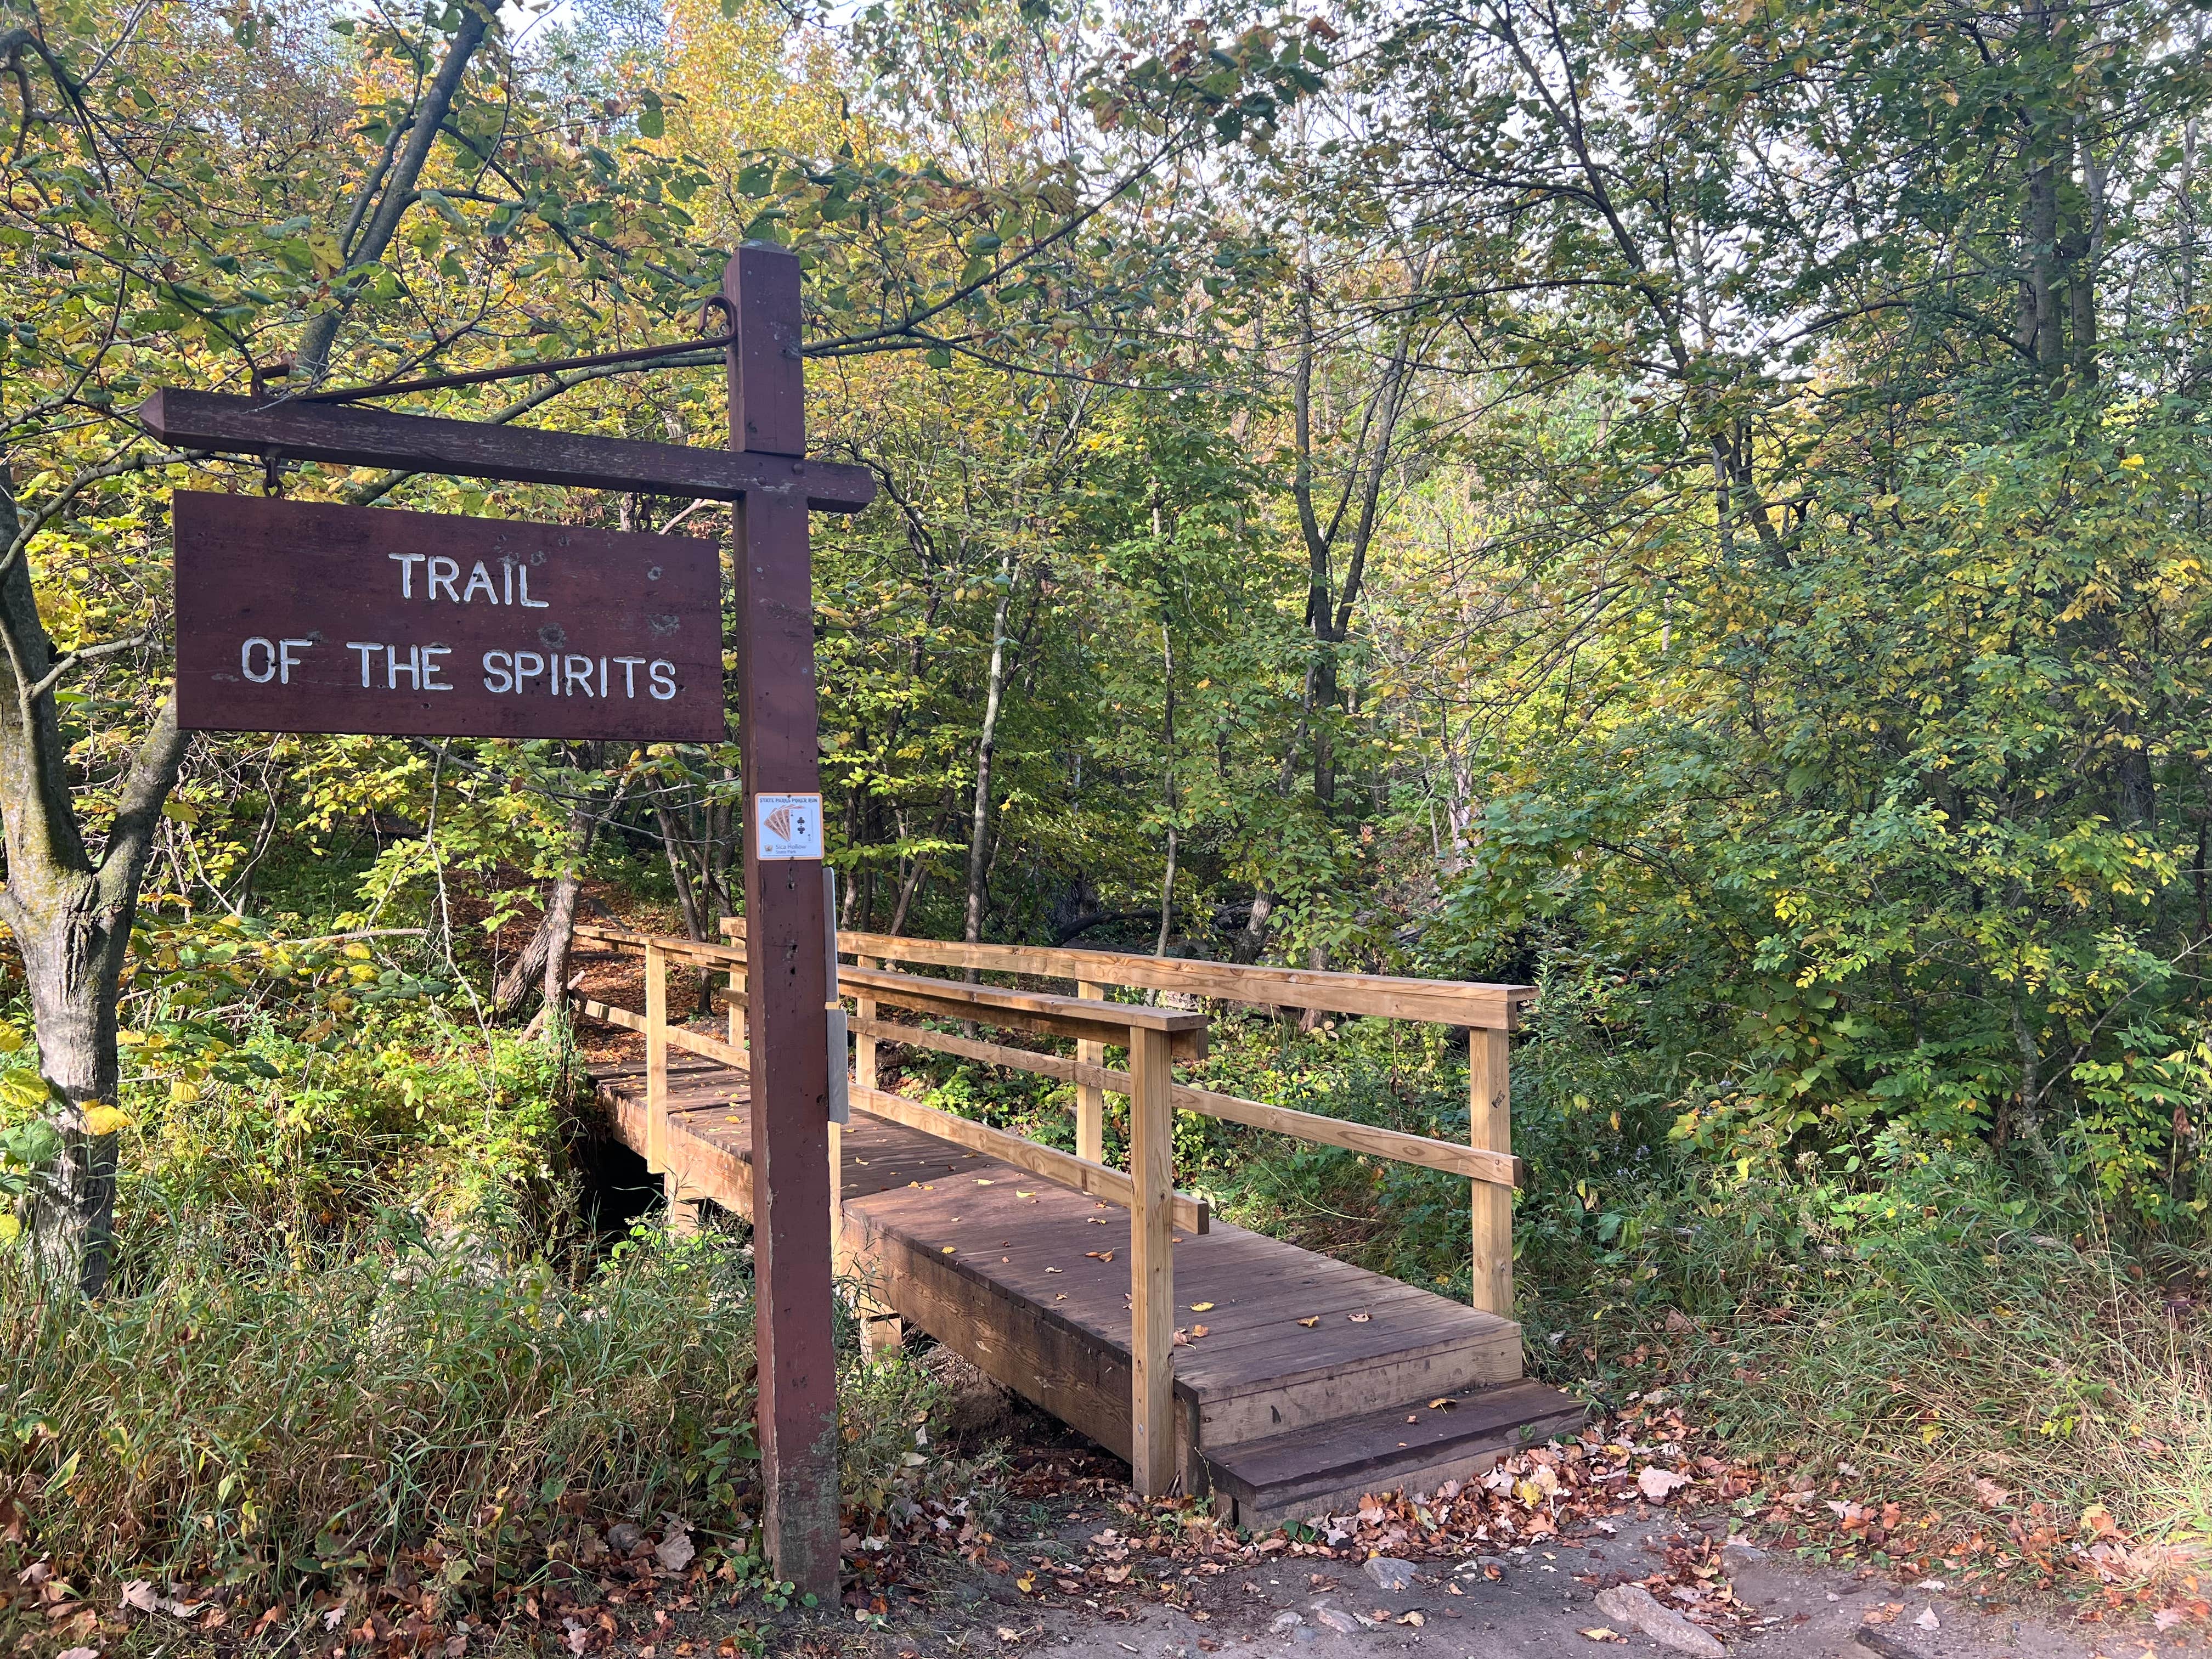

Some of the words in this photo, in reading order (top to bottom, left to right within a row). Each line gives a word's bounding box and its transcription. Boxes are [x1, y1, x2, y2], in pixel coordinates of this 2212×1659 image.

[388, 552, 549, 608] TRAIL
[241, 636, 313, 685] OF
[346, 641, 454, 691] THE
[482, 650, 677, 701] SPIRITS
